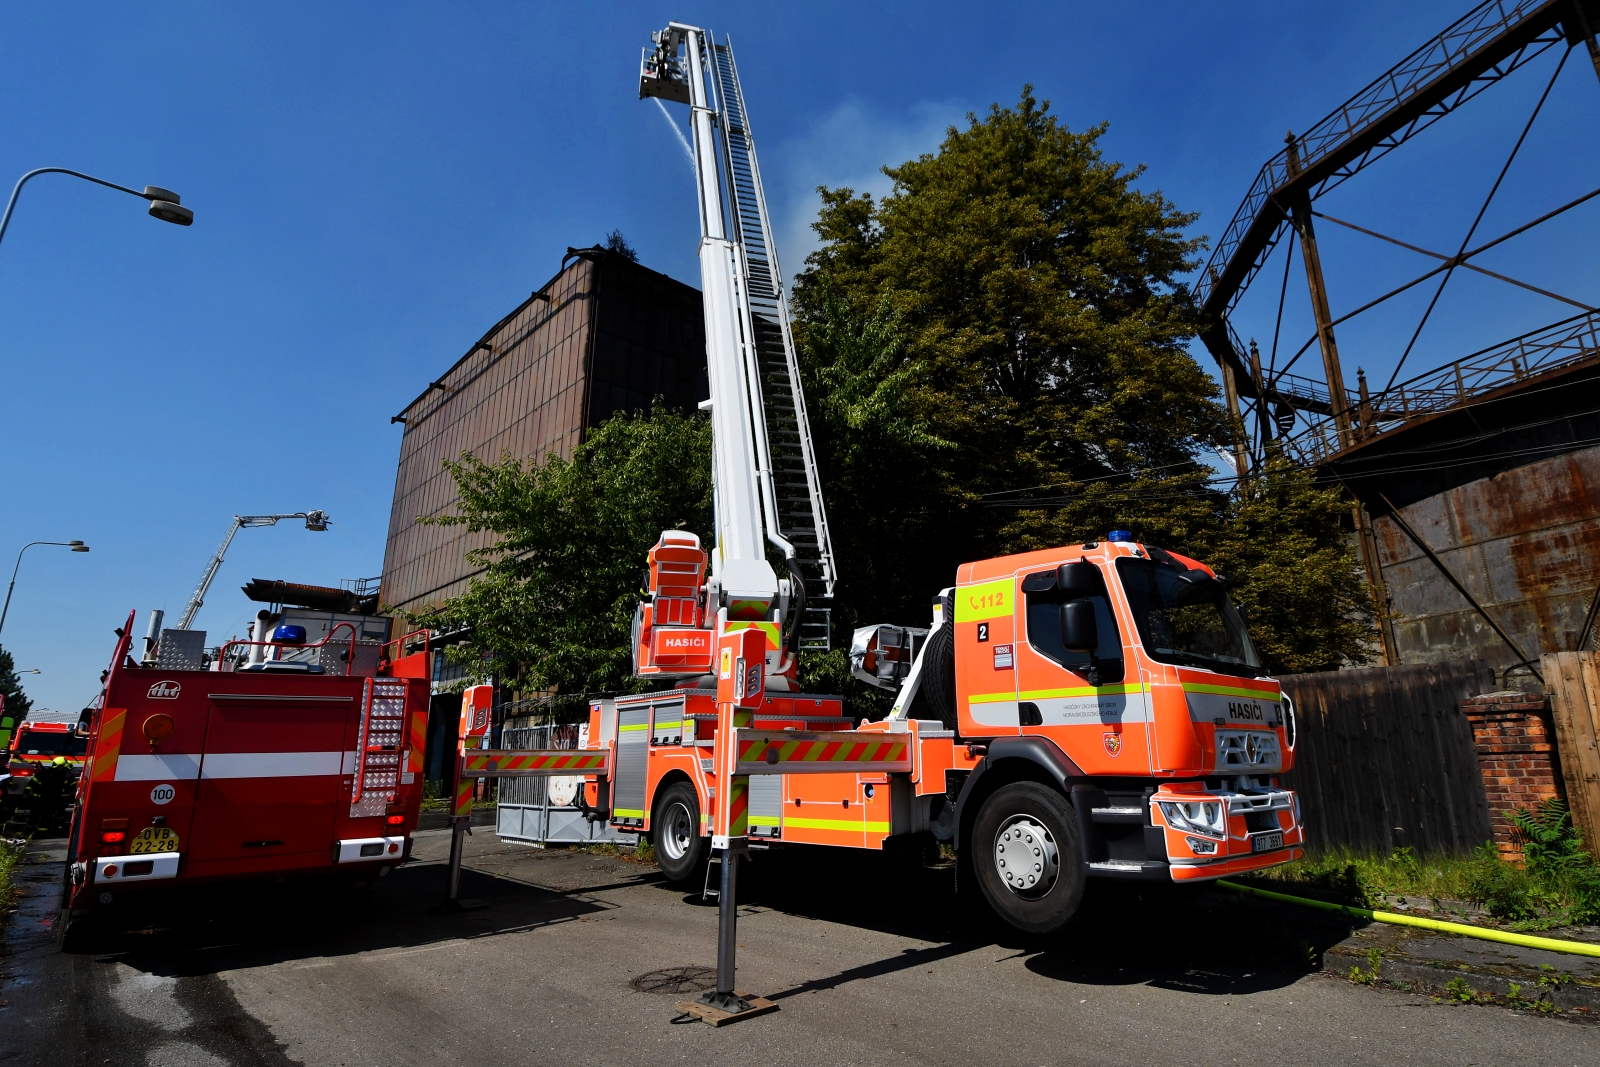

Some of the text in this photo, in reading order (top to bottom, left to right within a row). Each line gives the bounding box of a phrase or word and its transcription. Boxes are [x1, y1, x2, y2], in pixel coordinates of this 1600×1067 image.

[980, 591, 1004, 609] 112
[979, 625, 987, 640] 2
[665, 636, 705, 647] HASIČI
[1228, 700, 1263, 720] HASIČI
[153, 789, 173, 800] 100
[143, 828, 170, 840] OVB
[134, 840, 175, 853] 22-28
